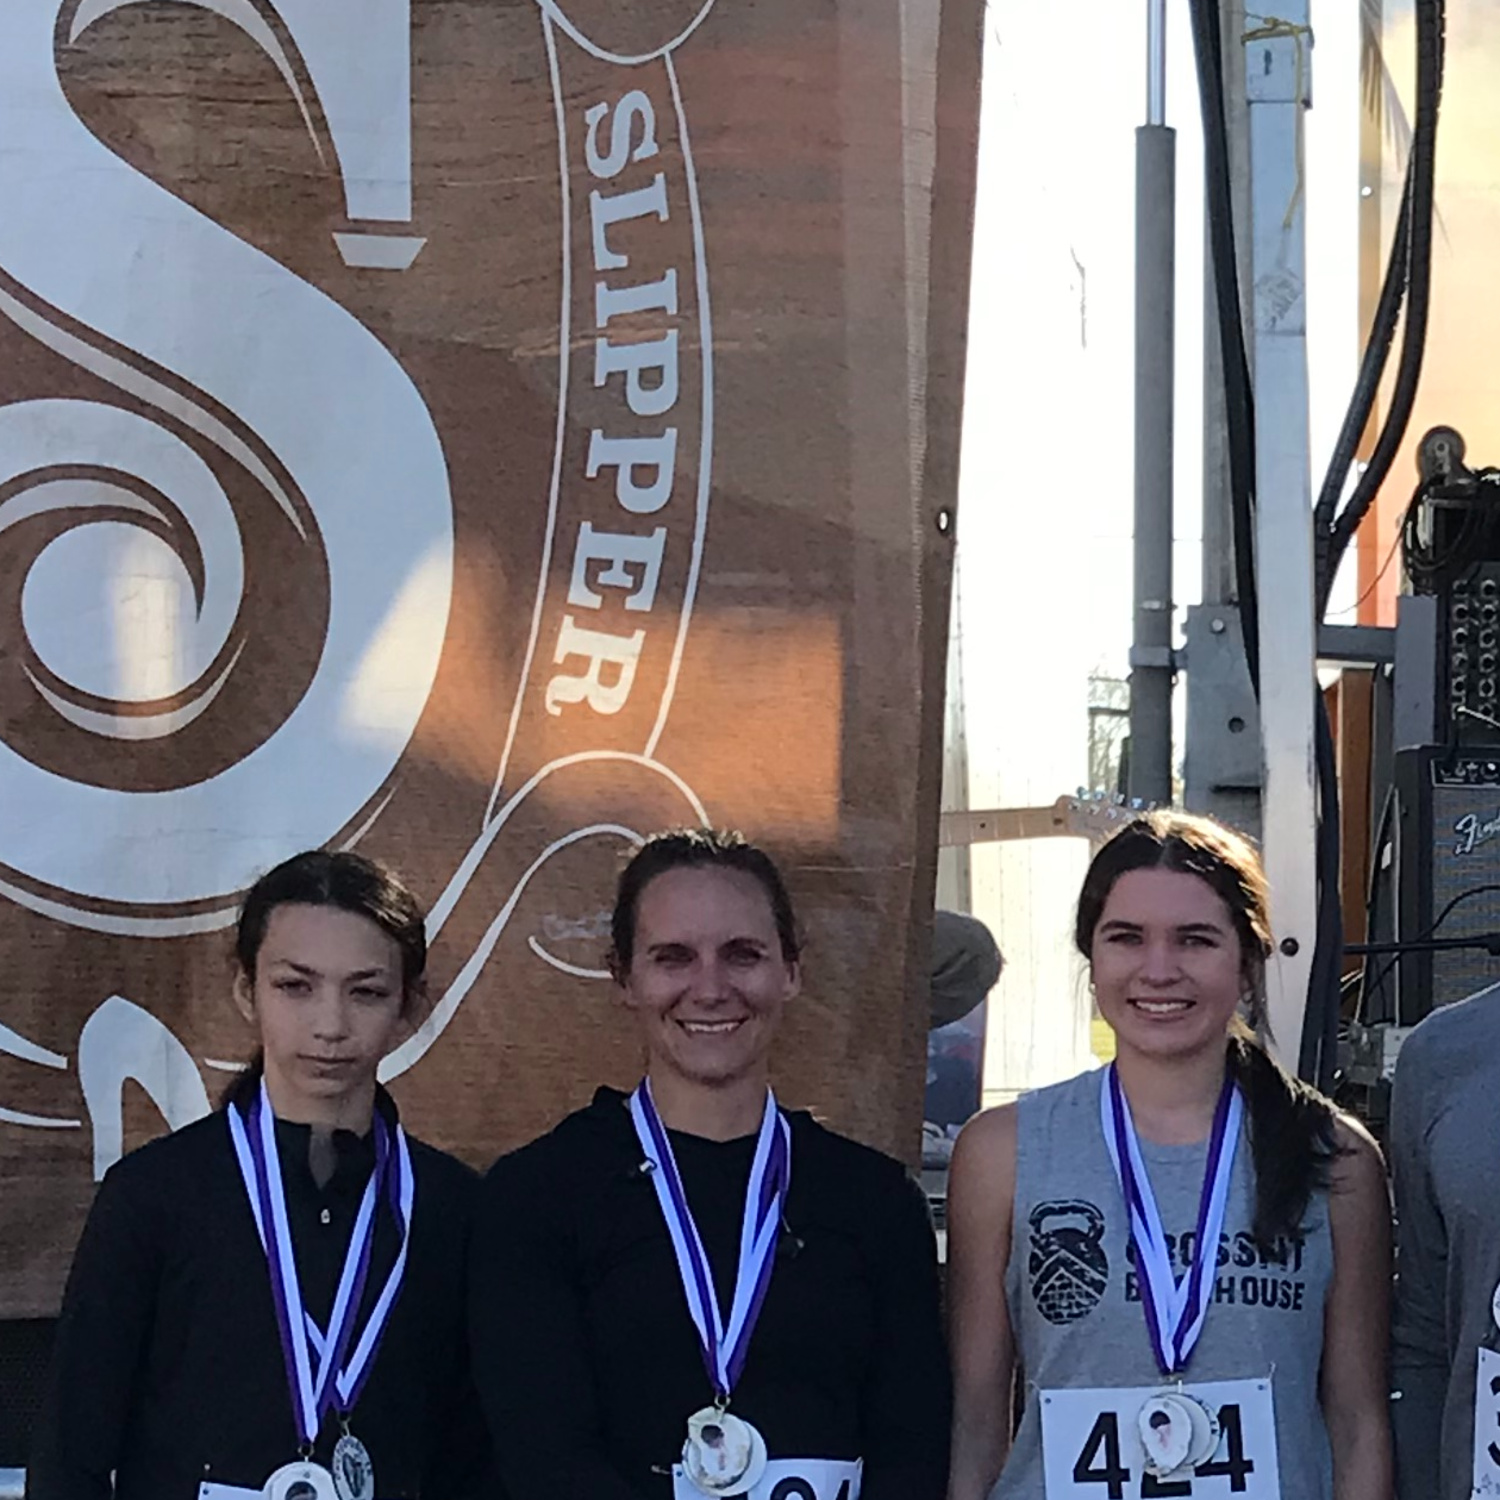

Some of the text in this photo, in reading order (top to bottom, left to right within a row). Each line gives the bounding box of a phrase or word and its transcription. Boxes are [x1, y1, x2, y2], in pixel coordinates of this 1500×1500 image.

[545, 89, 680, 718] SLIPPER
[1125, 1231, 1306, 1273] ROSST
[1125, 1272, 1306, 1311] BHOUSE
